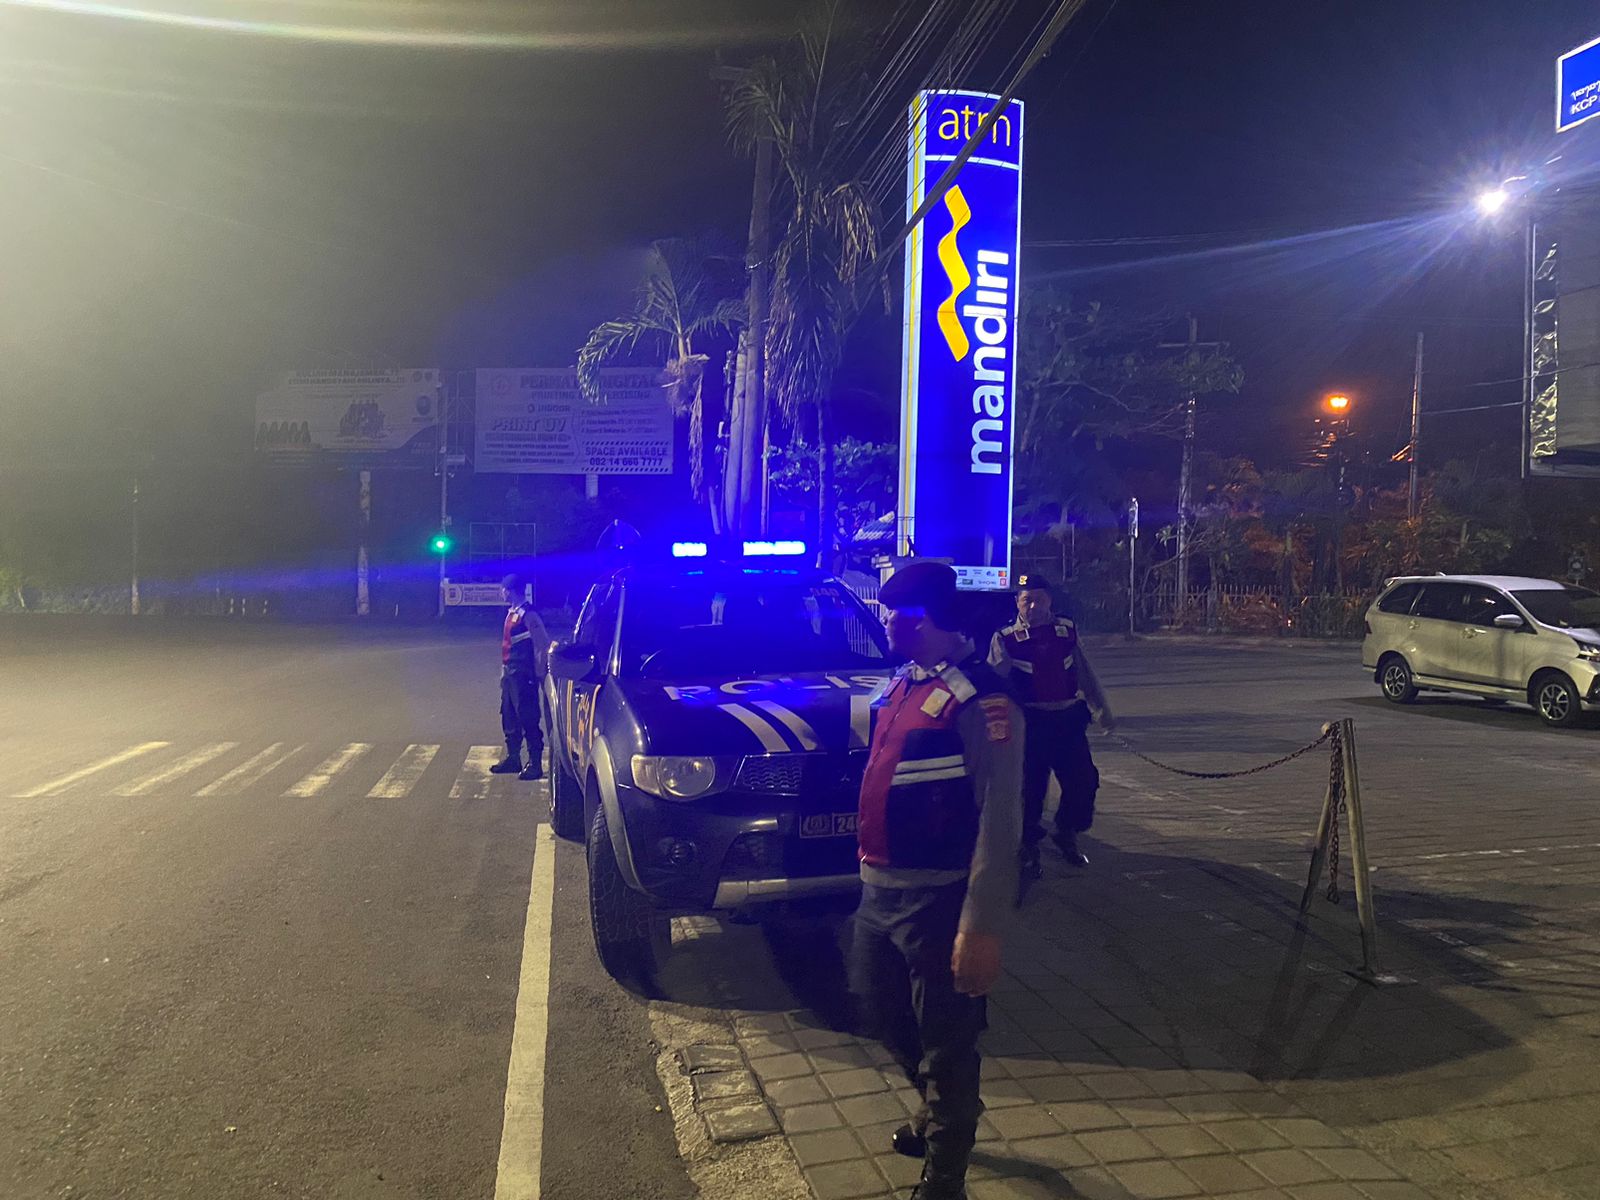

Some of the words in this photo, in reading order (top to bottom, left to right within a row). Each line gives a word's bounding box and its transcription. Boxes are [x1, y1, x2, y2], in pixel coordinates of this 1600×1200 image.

[1570, 95, 1598, 115] KCP
[938, 105, 1011, 147] atm
[962, 249, 1009, 475] mandiri
[585, 446, 615, 456] SPACE
[617, 446, 668, 456] AVAILABLE
[609, 457, 620, 466] 14
[641, 457, 663, 466] 7777
